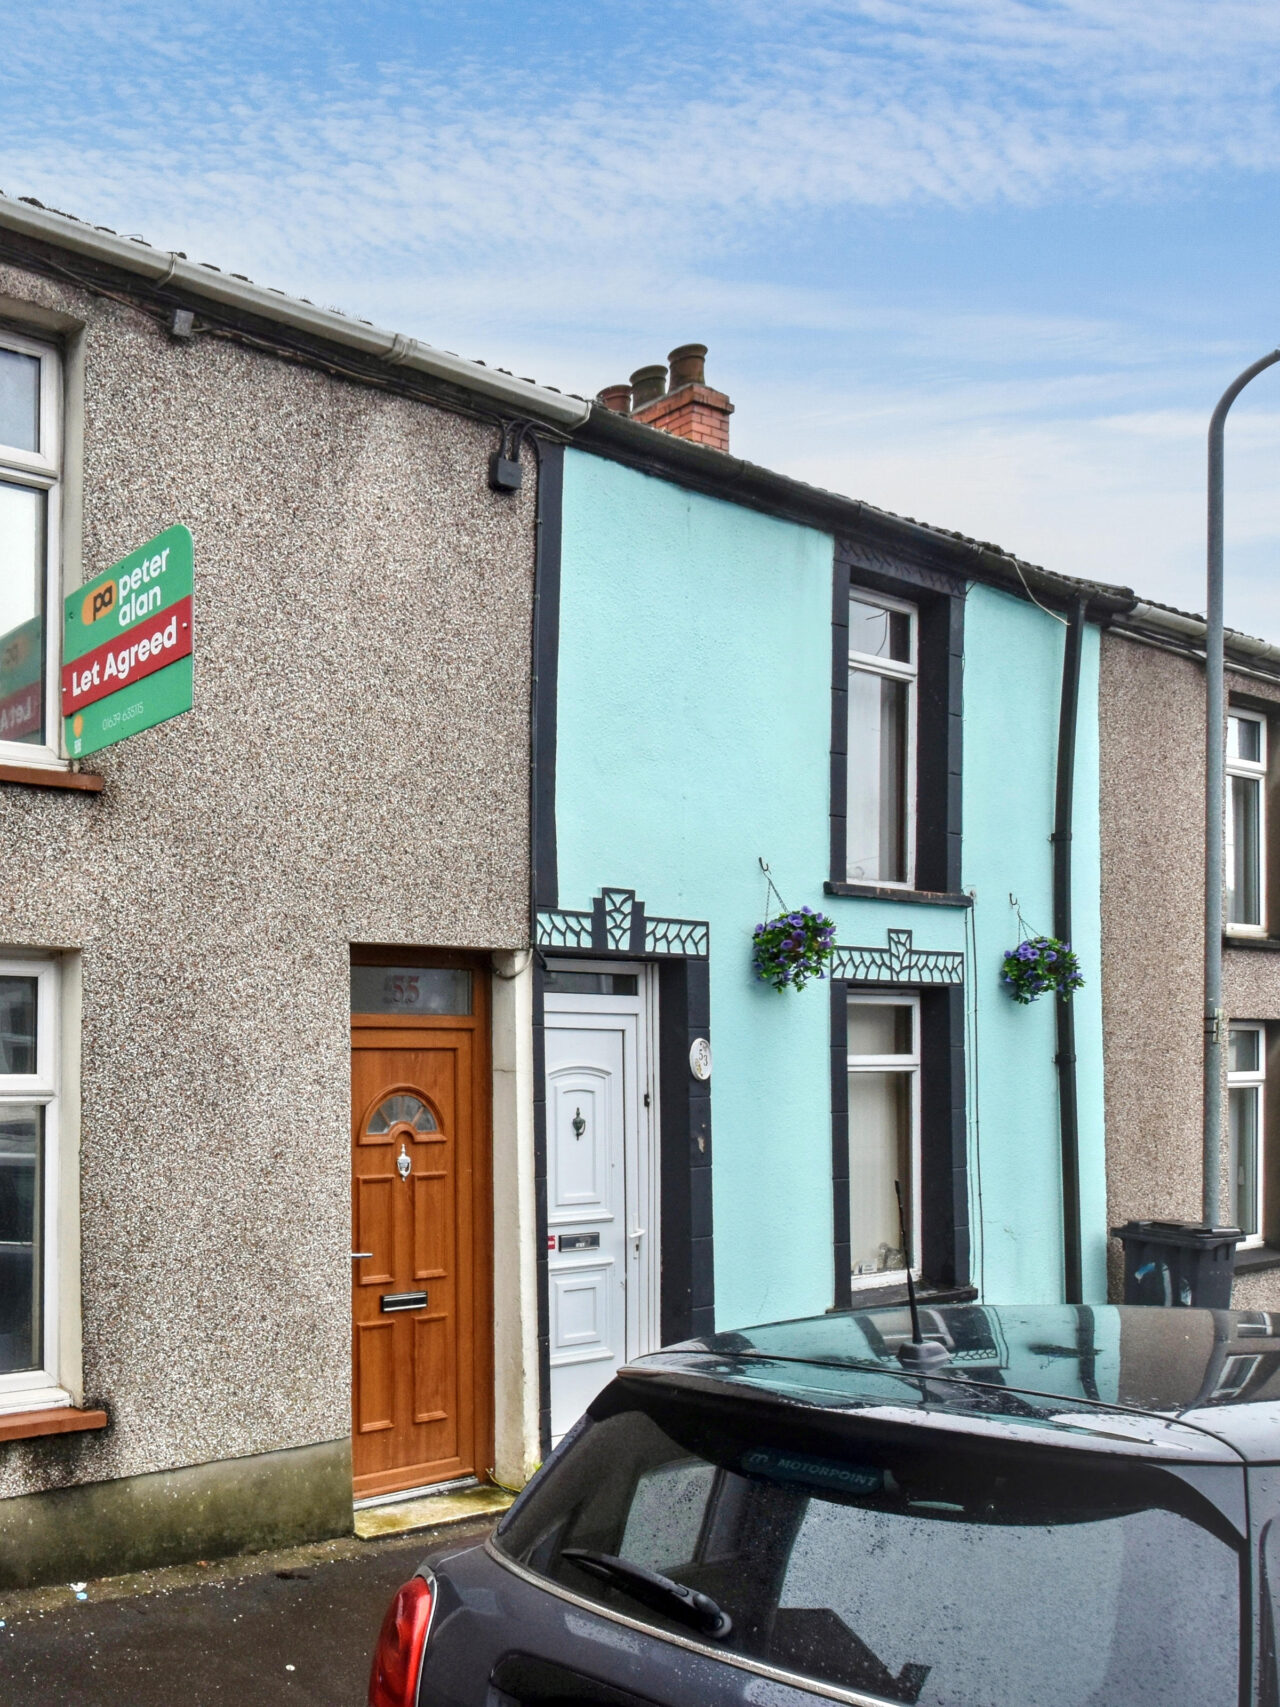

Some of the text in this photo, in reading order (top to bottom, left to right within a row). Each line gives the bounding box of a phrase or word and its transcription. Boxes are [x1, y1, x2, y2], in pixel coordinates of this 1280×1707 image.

[119, 547, 170, 605] peter
[93, 585, 113, 622] pa
[119, 585, 162, 627] alan
[72, 615, 177, 697] Let Agreed
[392, 975, 420, 1003] 55
[699, 1049, 708, 1067] 53
[777, 1459, 877, 1487] MOTORPOINT
